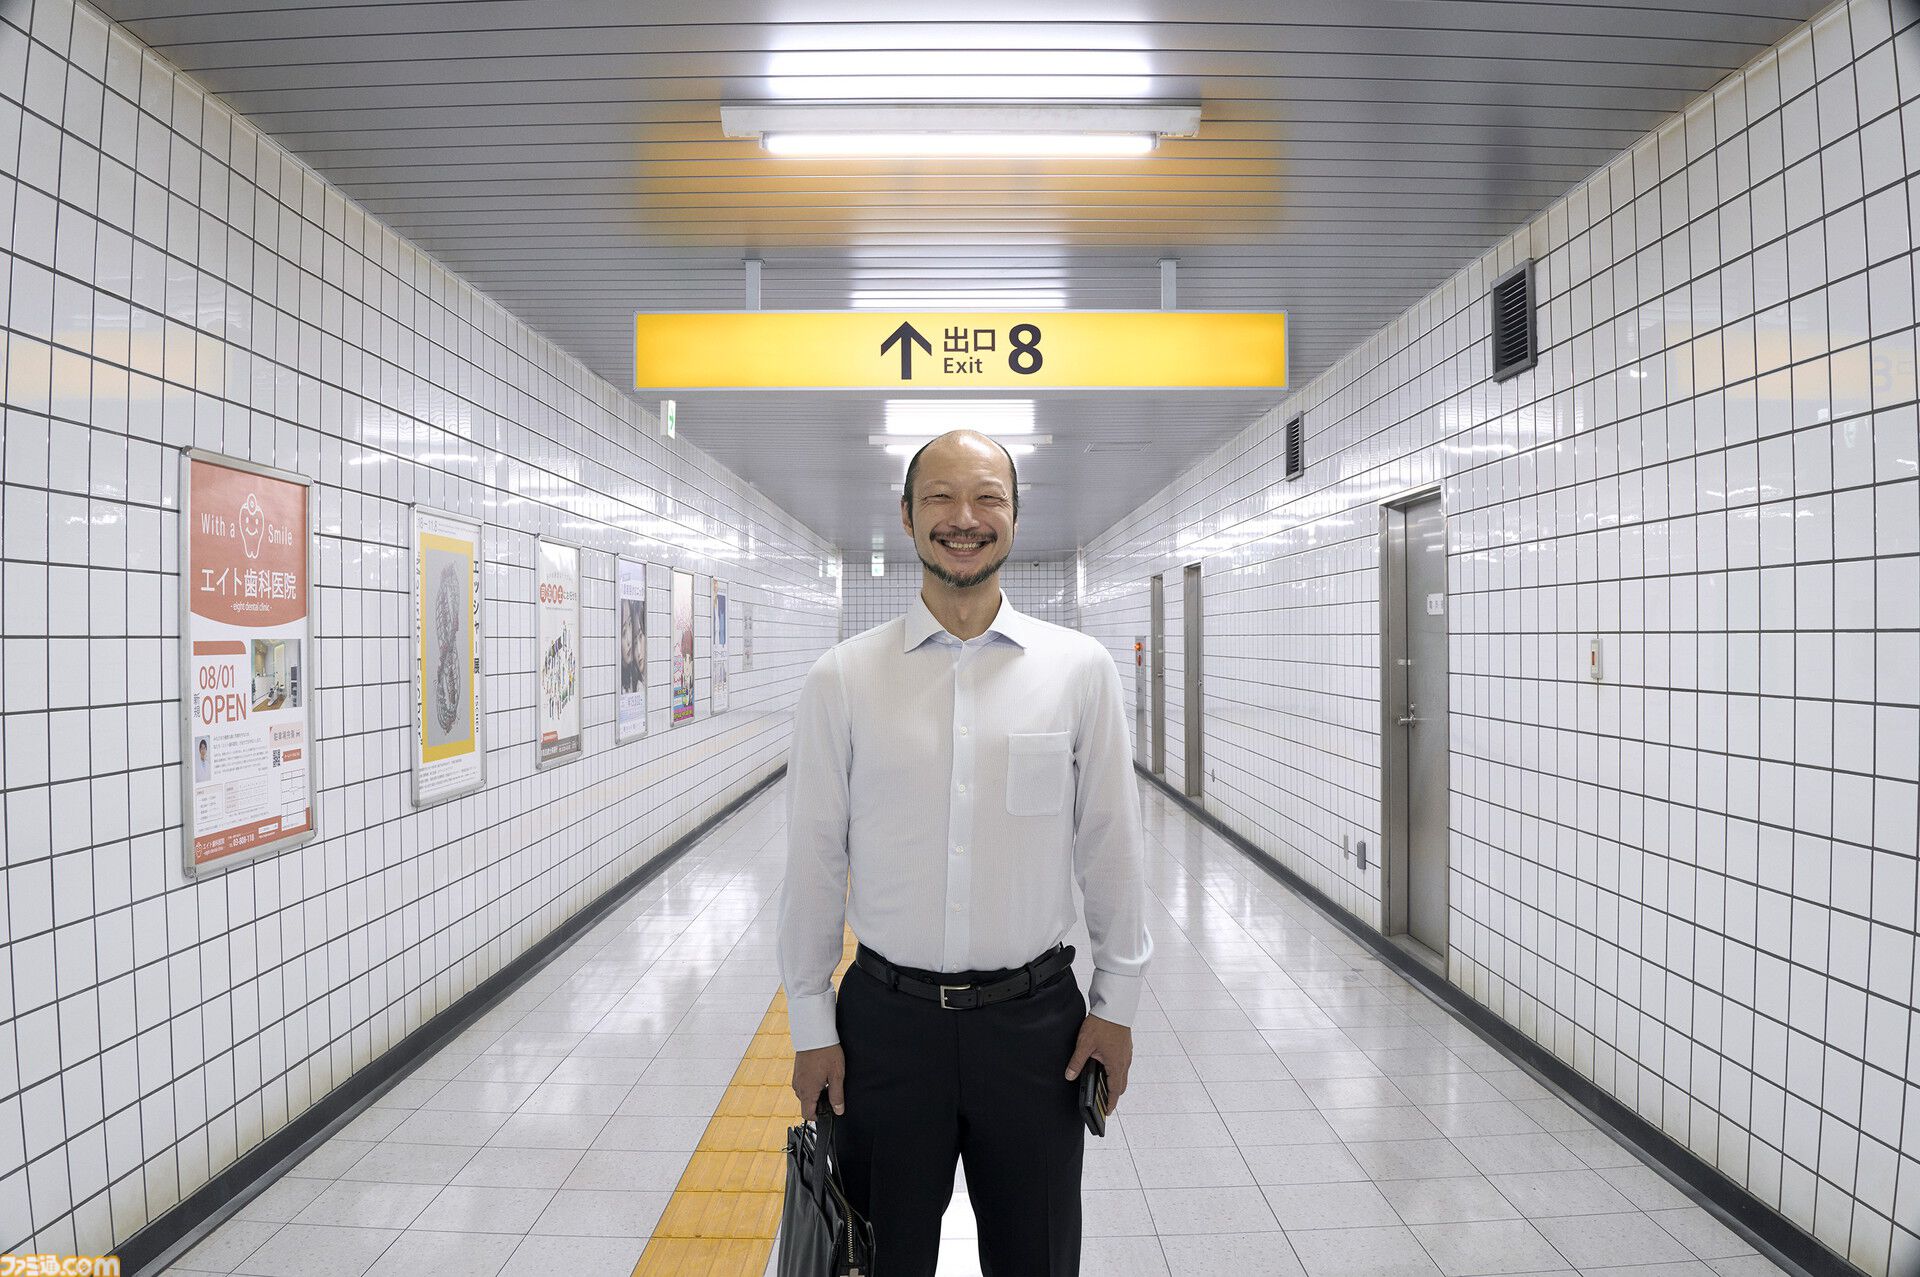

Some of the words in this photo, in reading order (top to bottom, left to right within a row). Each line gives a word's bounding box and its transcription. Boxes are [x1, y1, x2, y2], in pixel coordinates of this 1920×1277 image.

[944, 326, 996, 353] 出口
[1008, 323, 1044, 375] 8
[943, 357, 983, 374] Exit
[201, 513, 226, 537] With
[230, 523, 236, 538] a
[268, 524, 293, 546] Smile
[201, 567, 297, 600] エイト歯科医院
[199, 665, 235, 690] 08/01
[202, 692, 247, 725] OPEN
